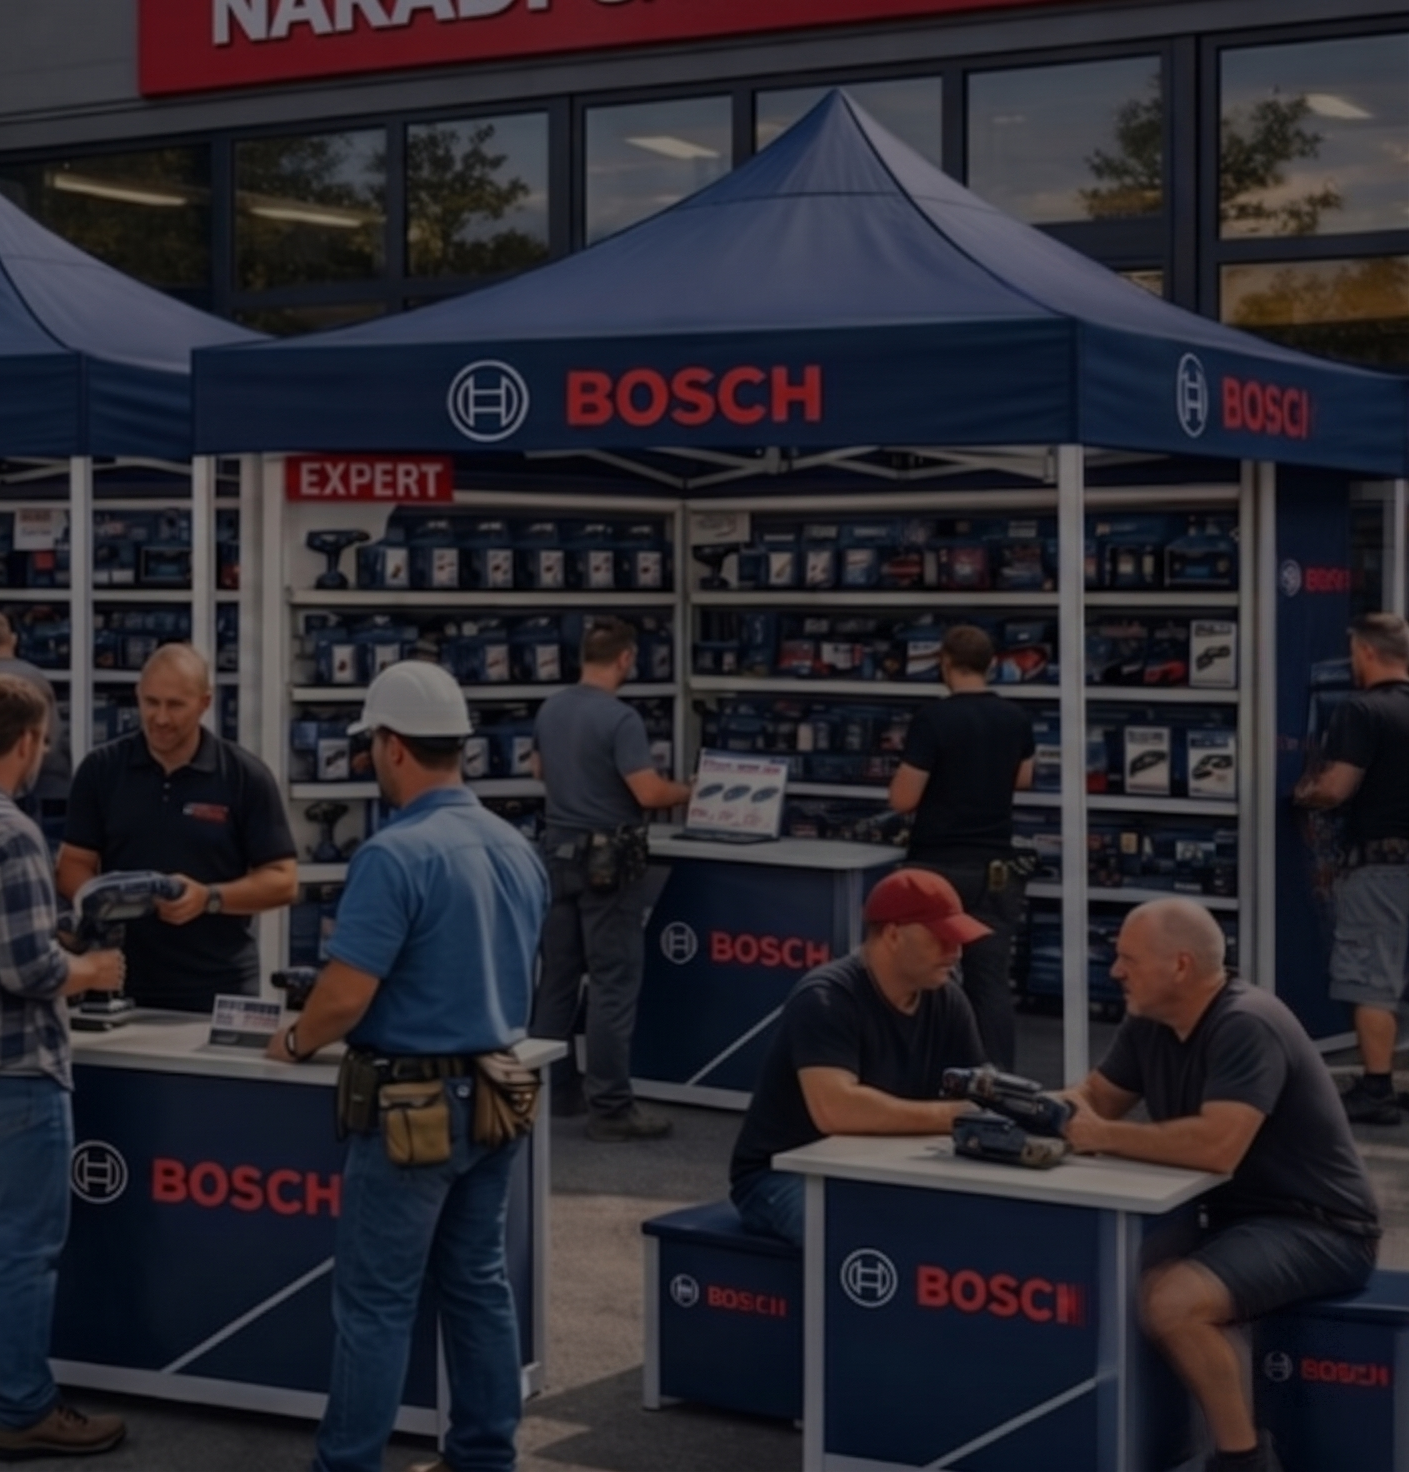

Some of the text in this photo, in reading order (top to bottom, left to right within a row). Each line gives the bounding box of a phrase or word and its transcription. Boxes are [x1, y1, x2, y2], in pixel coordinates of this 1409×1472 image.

[565, 364, 823, 428] BOSCH
[299, 461, 445, 498] EXPERT
[710, 931, 831, 970] BOSCH
[150, 1157, 342, 1217] BOSCH
